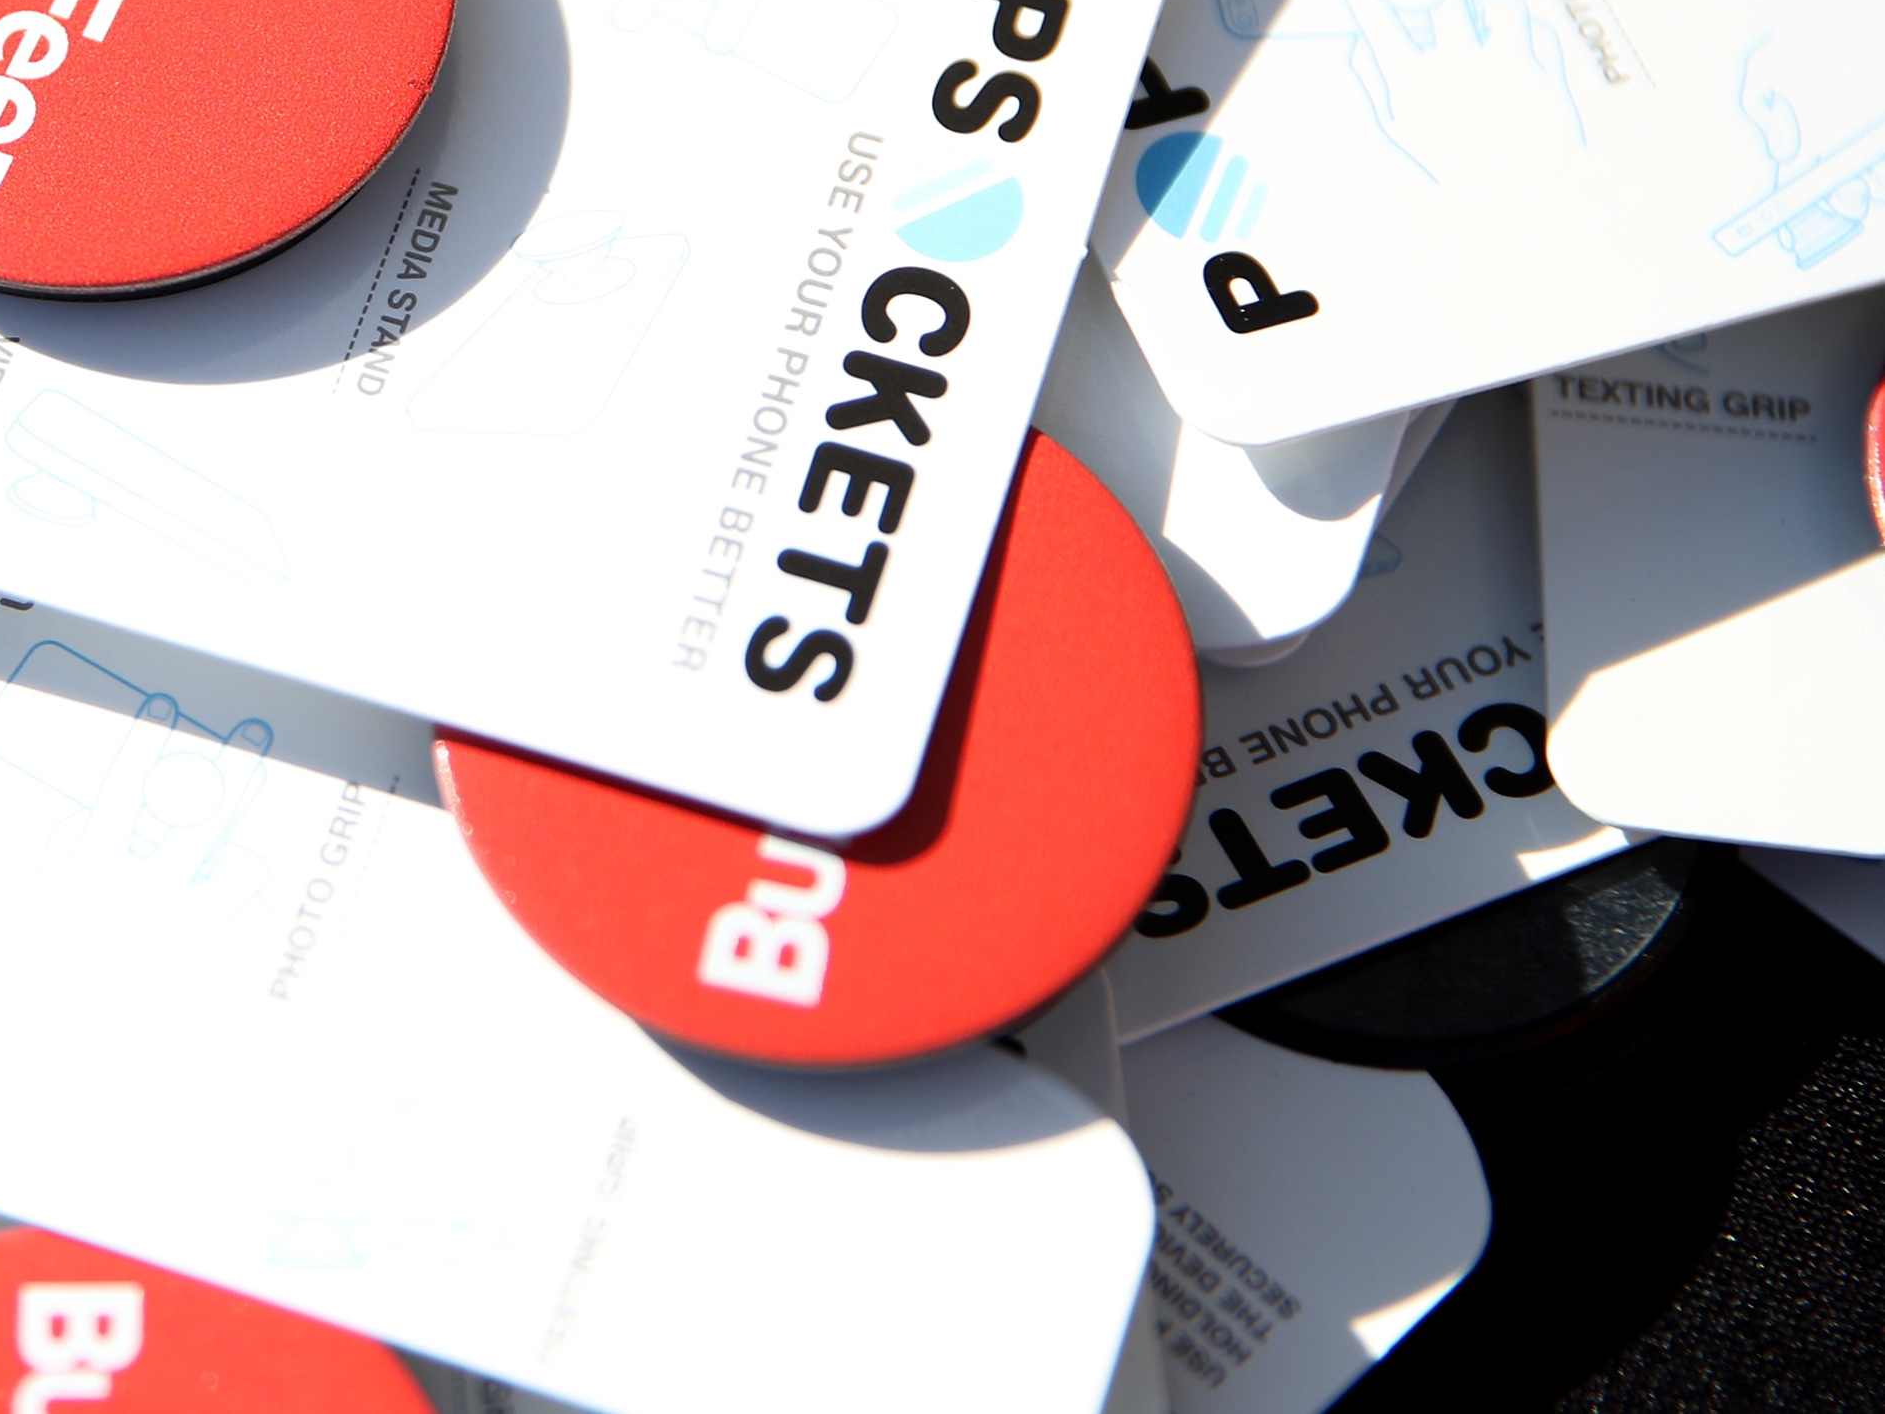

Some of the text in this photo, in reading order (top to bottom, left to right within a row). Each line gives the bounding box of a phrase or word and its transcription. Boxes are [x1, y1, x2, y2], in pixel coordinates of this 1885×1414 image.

[357, 182, 458, 395] MEDIA STAND
[672, 130, 883, 672] USE YOUR PHONE BETTER
[1552, 374, 1812, 424] TEXTING GRIP
[1239, 683, 1400, 765] PHONE
[1402, 636, 1532, 701] YOUR
[268, 780, 366, 1002] PHOTO GRIP
